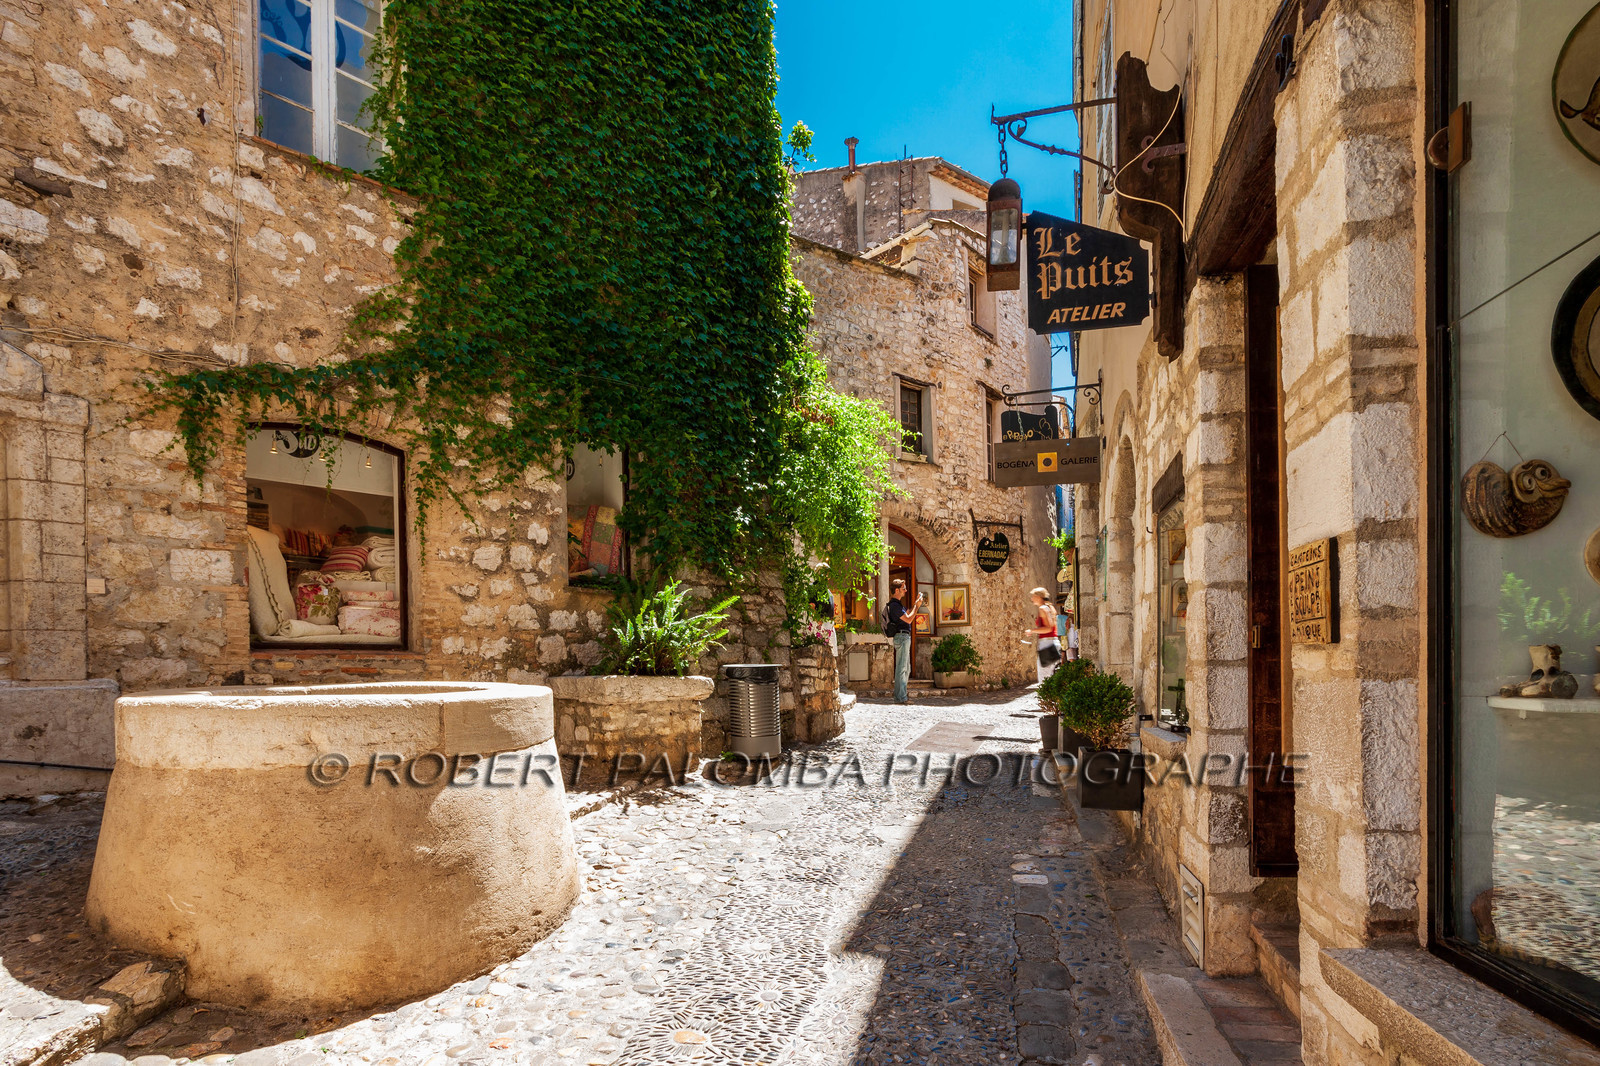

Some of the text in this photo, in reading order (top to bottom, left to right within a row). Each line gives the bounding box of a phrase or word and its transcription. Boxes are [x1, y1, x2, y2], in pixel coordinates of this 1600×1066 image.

[1034, 227, 1082, 259] Le
[1036, 256, 1134, 300] Puits
[1047, 302, 1126, 325] ATELIER
[1061, 456, 1098, 465] GALERIE
